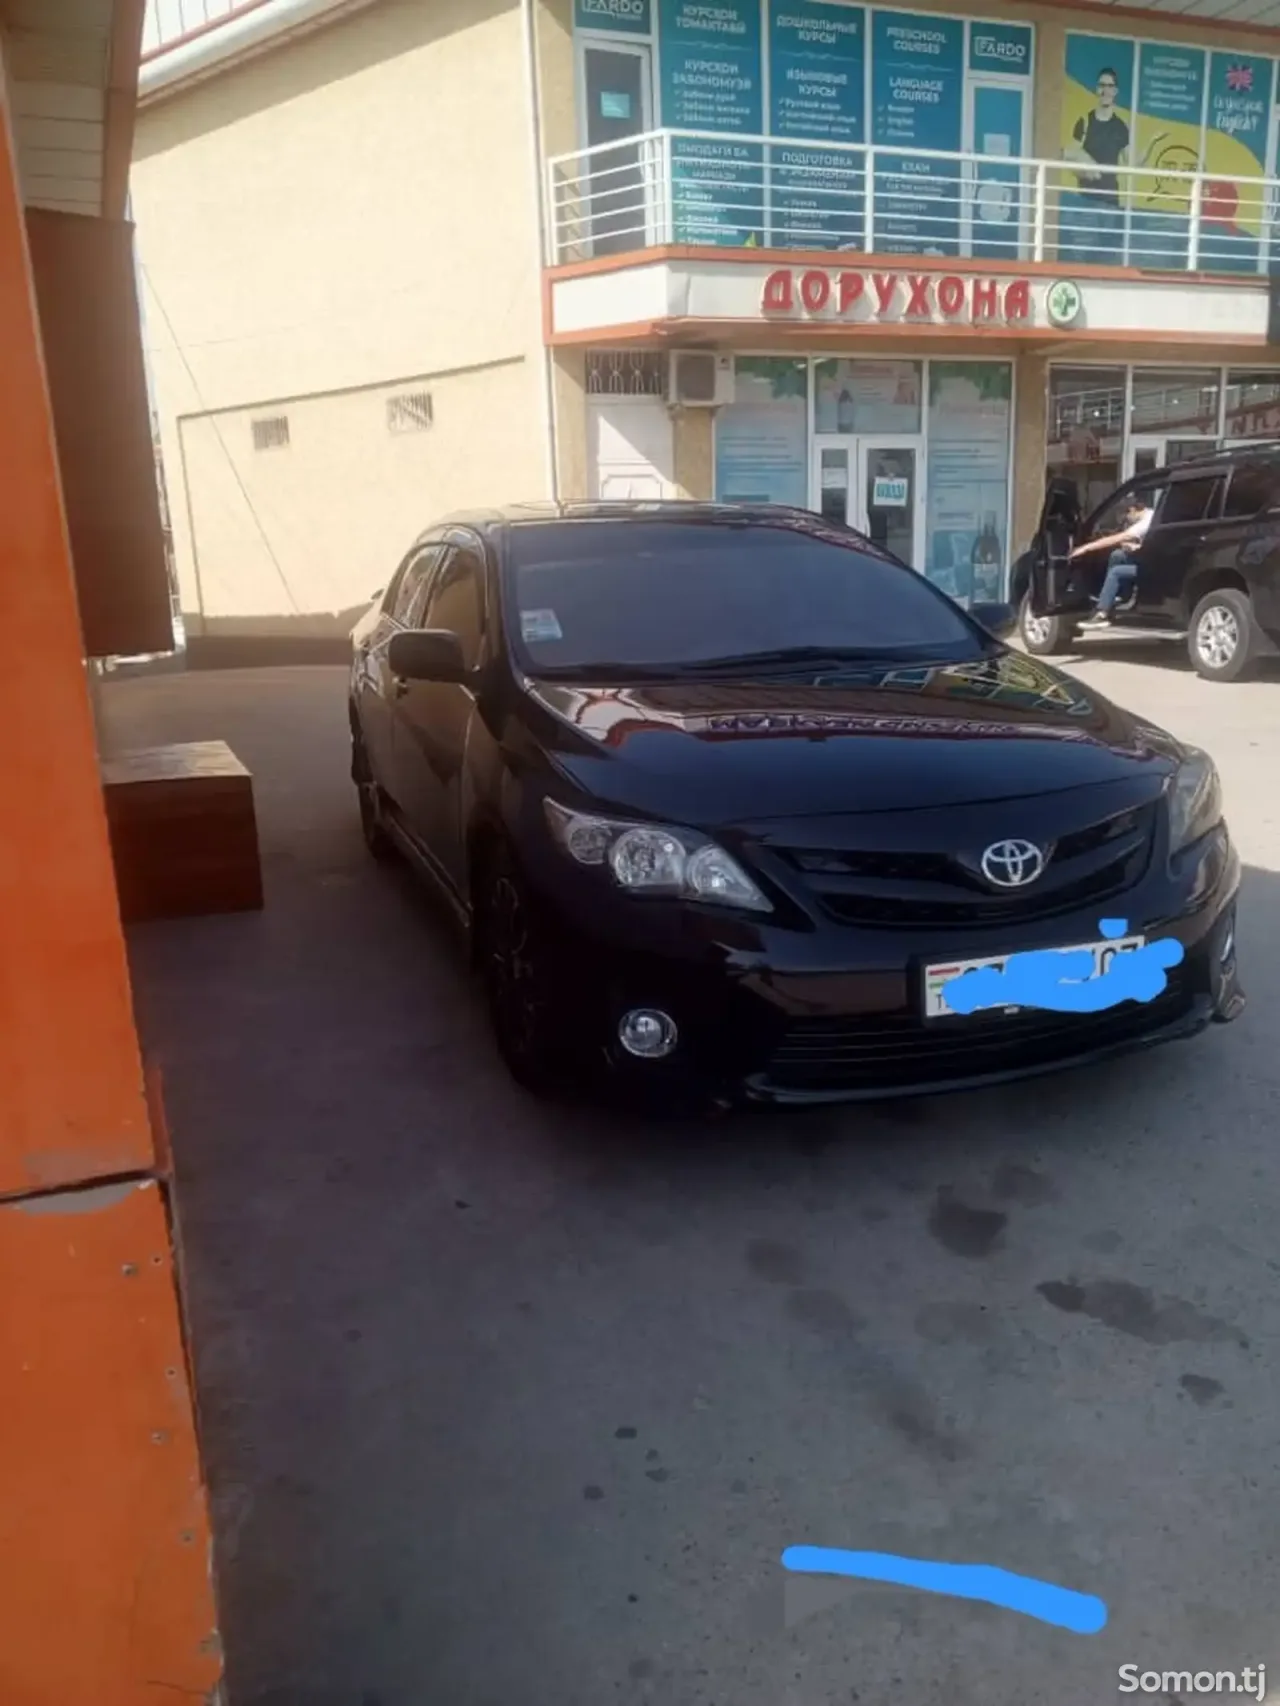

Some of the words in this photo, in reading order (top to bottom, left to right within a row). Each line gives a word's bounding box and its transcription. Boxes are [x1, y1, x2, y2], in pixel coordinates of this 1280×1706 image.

[798, 30, 836, 44] КУРСЫ
[886, 26, 947, 43] PRESCHOOL
[893, 40, 940, 54] COURSES
[798, 84, 837, 97] КУРСЫ
[889, 76, 944, 92] LANGUAGE
[892, 89, 941, 103] COURSES
[782, 152, 853, 166] ПОДГОТОВКА
[761, 269, 1031, 319] ДОРУХОНА
